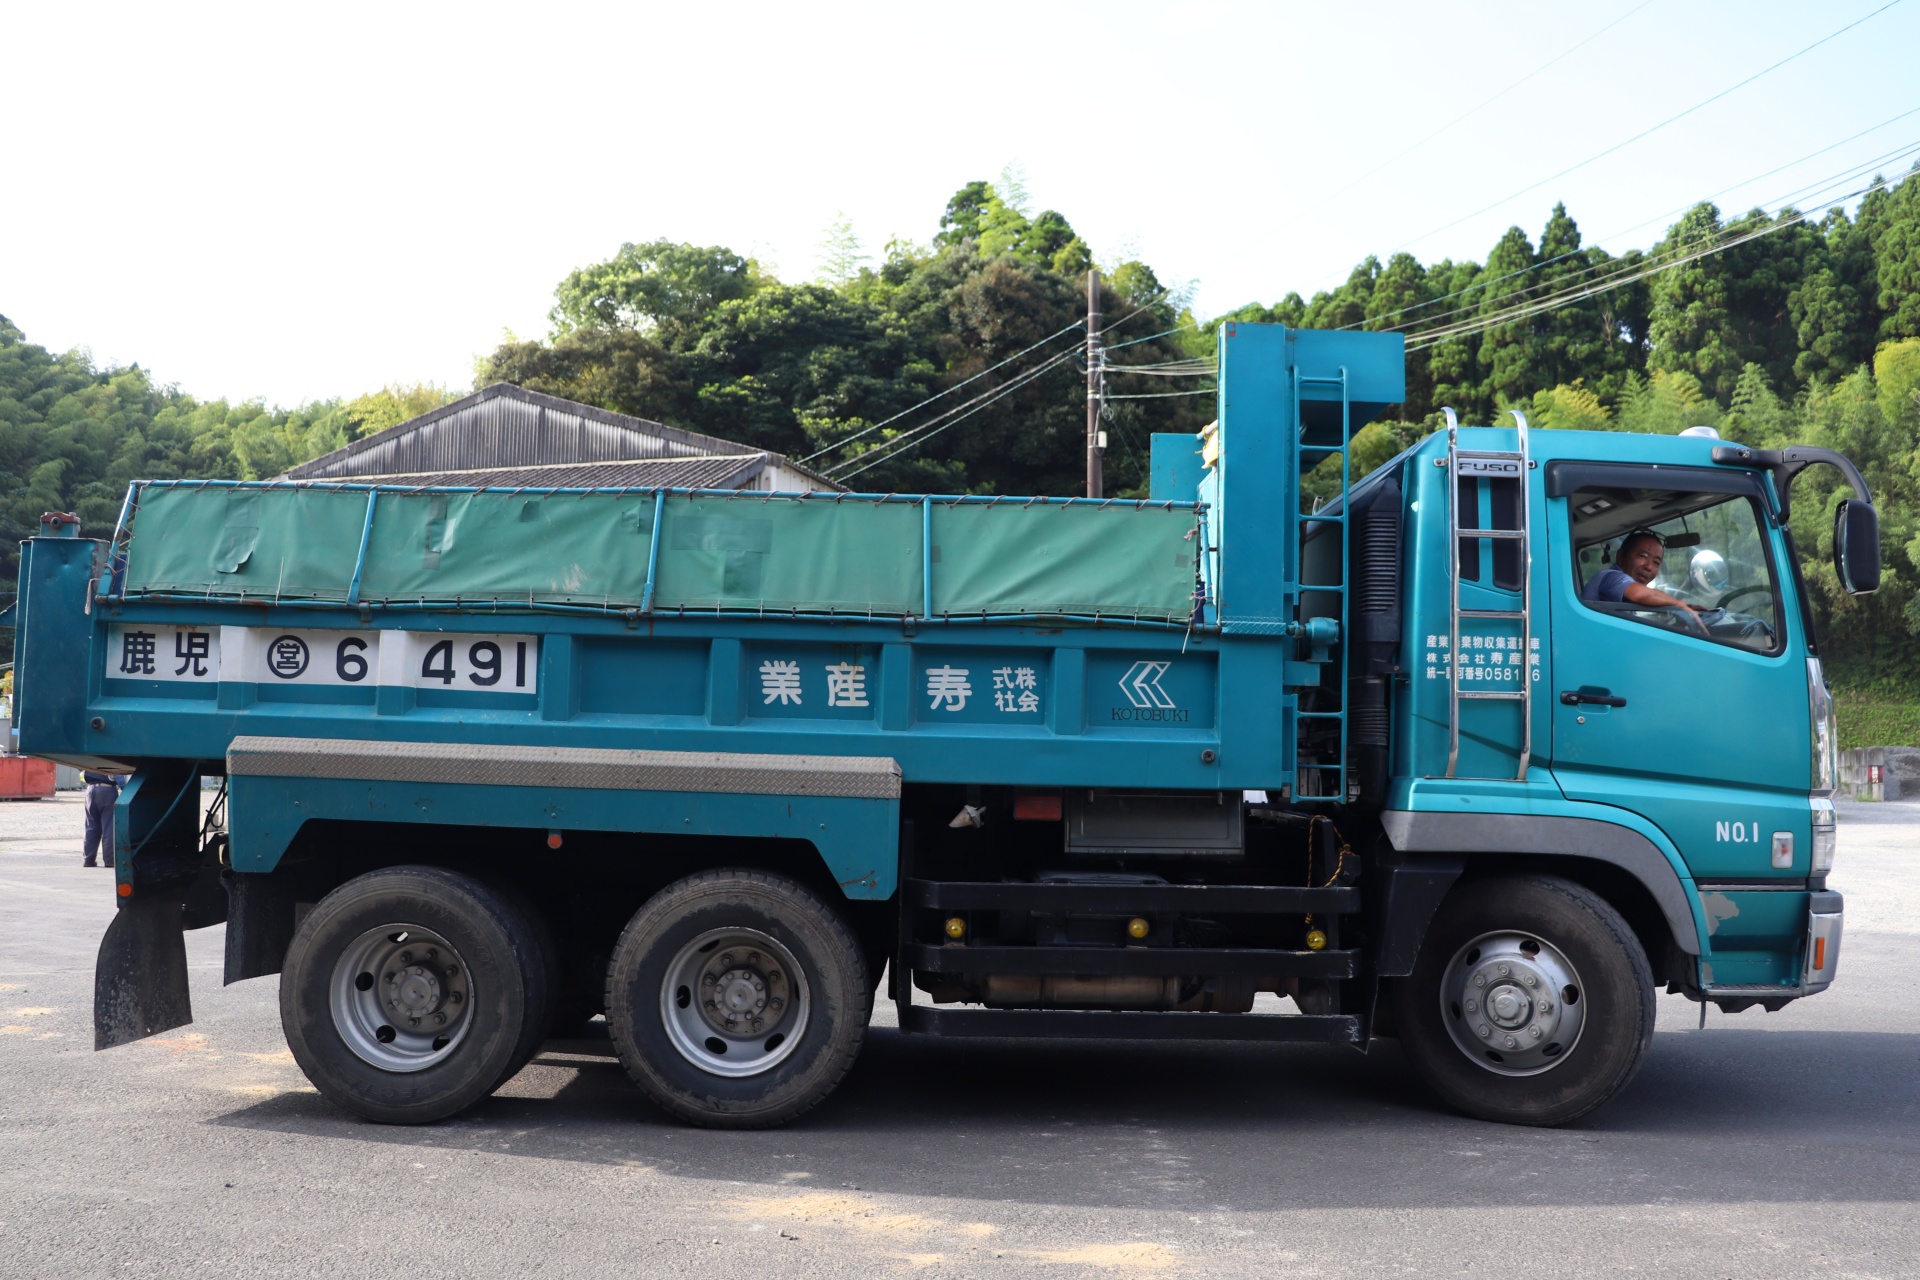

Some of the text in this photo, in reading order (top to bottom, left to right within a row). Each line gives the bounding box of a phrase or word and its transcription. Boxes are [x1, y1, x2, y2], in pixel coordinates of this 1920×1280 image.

[1459, 463, 1518, 472] FUSO
[1426, 635, 1540, 650] 産業棄物収集運車
[119, 630, 209, 677] 鹿児
[336, 637, 369, 682] 6
[421, 640, 527, 688] 491
[1111, 707, 1190, 722] KOTOBUKI
[1716, 821, 1759, 843] NO.1
